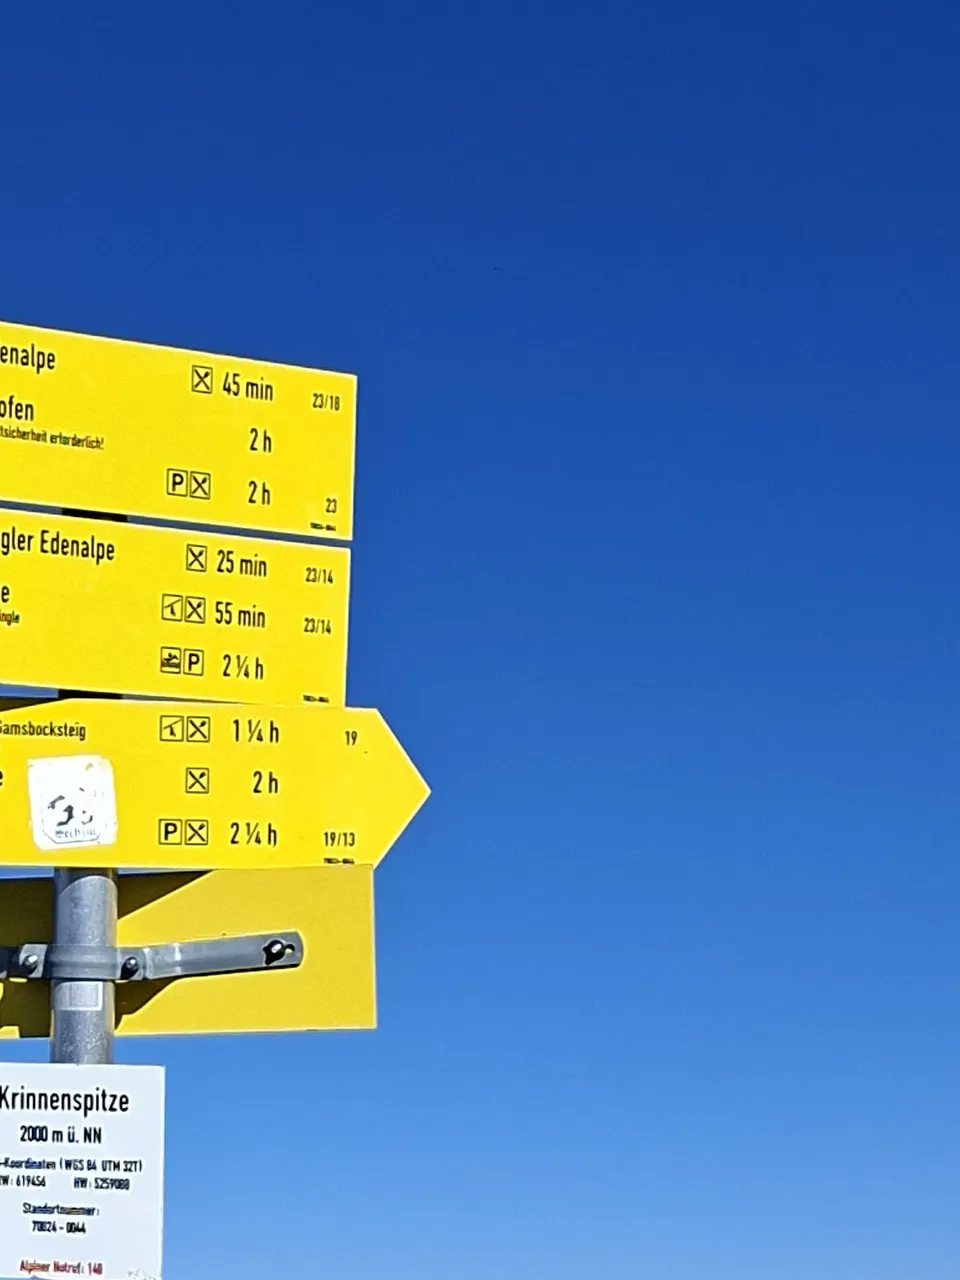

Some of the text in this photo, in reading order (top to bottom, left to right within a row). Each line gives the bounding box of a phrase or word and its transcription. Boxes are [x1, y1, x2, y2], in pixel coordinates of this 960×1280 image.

[222, 371, 274, 401] 45 min
[312, 393, 341, 411] 23/18
[49, 431, 105, 450] erforderlich!
[249, 427, 272, 453] 2 h
[248, 480, 271, 505] 2 h
[325, 498, 337, 514] 23
[40, 529, 115, 565] Edenalpe
[216, 549, 267, 577] 25 min
[305, 567, 334, 585] 23/14
[215, 600, 266, 629] 55 min
[303, 617, 332, 635] 23/14
[222, 654, 231, 677] 2
[255, 657, 264, 680] h
[233, 719, 240, 742] 1
[269, 720, 279, 743] h
[345, 730, 358, 746] 19
[253, 770, 279, 794] 2 h
[230, 822, 240, 845] 2
[267, 823, 277, 847] h
[323, 831, 356, 847] 19/13
[20, 1125, 102, 1144] 2000 m ü. NN
[101, 1160, 121, 1172] UTM
[123, 1159, 143, 1173] 32T)
[22, 1202, 100, 1216] Standortnummer:
[19, 1259, 51, 1274] Alpiner
